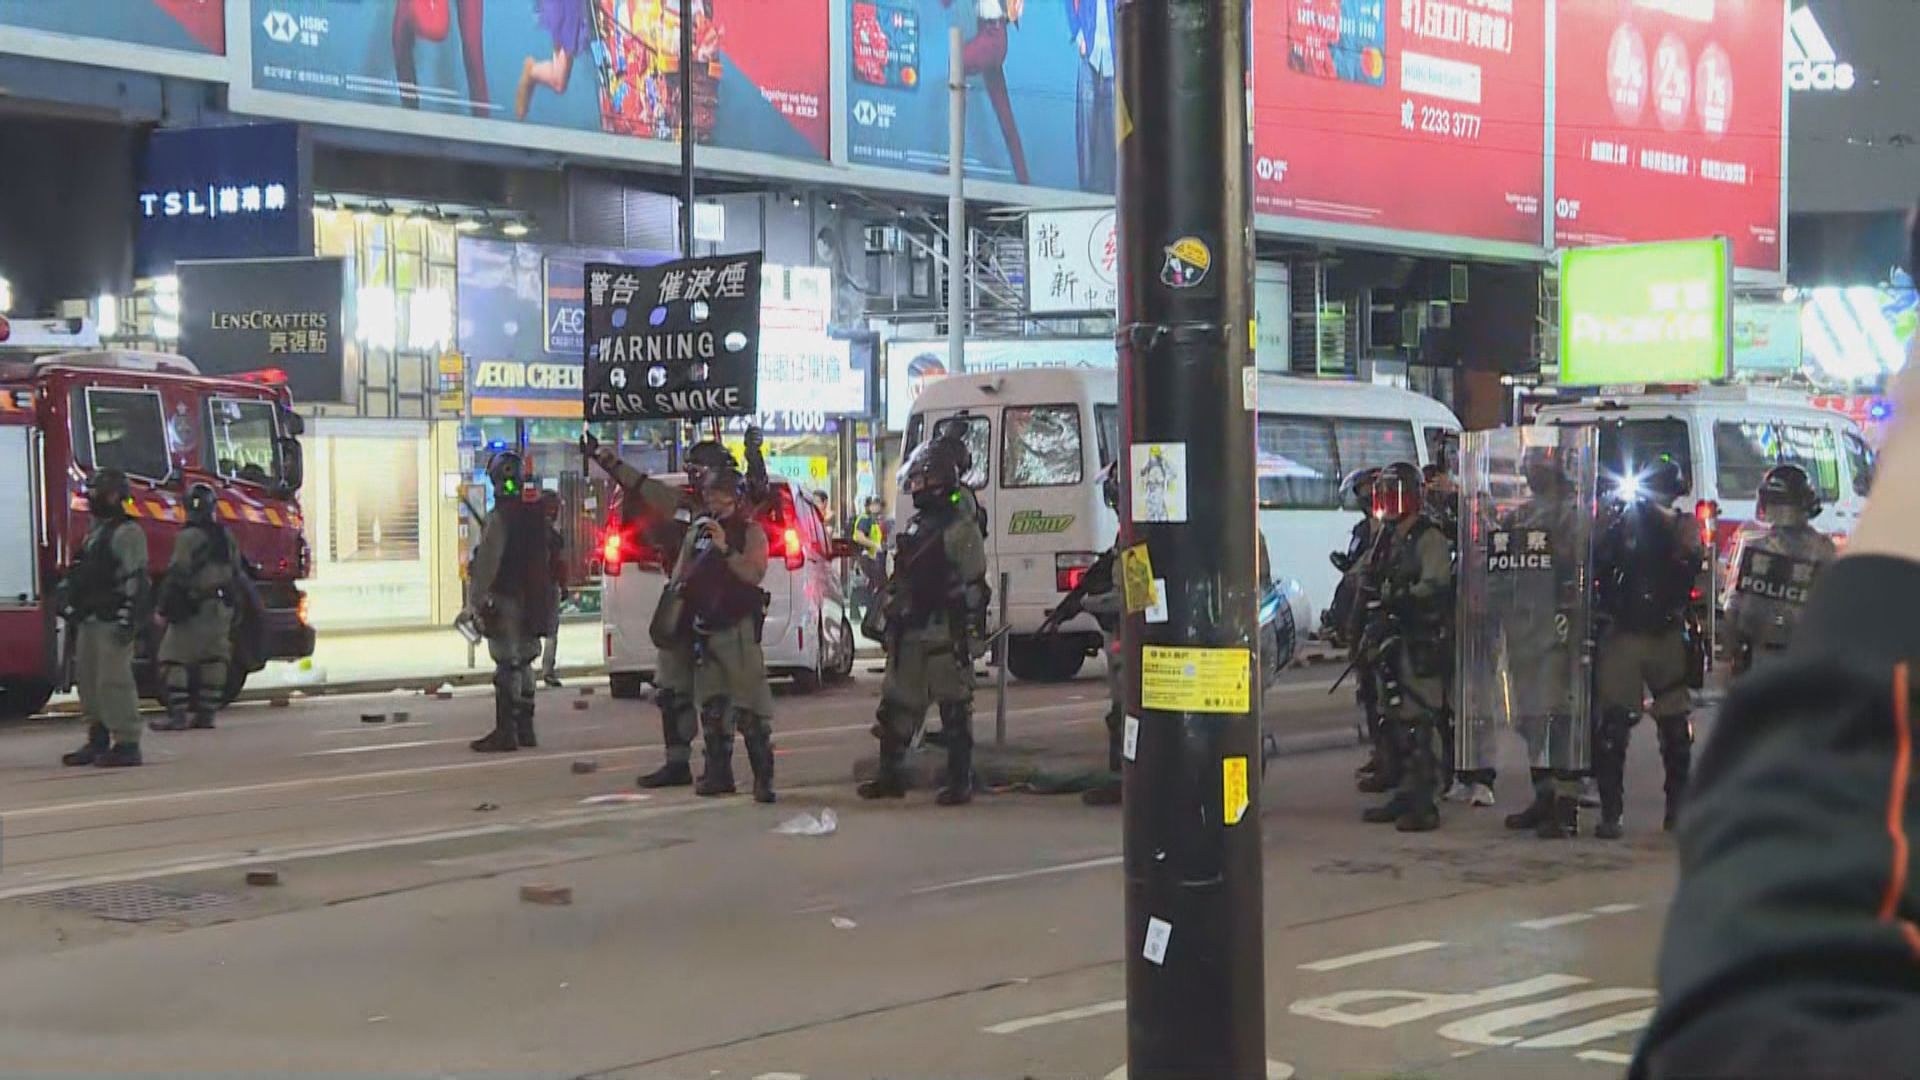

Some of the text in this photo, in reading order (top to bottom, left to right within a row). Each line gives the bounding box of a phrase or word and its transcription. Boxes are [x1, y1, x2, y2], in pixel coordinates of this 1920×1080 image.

[1421, 105, 1450, 136] 2233
[1452, 111, 1480, 139] 3777
[139, 190, 206, 216] TSL
[589, 271, 640, 306] 警告
[599, 332, 715, 362] WARNING
[589, 387, 743, 416] TEAR SMOKE
[781, 409, 825, 432] 1000
[1489, 553, 1552, 571] POLICE
